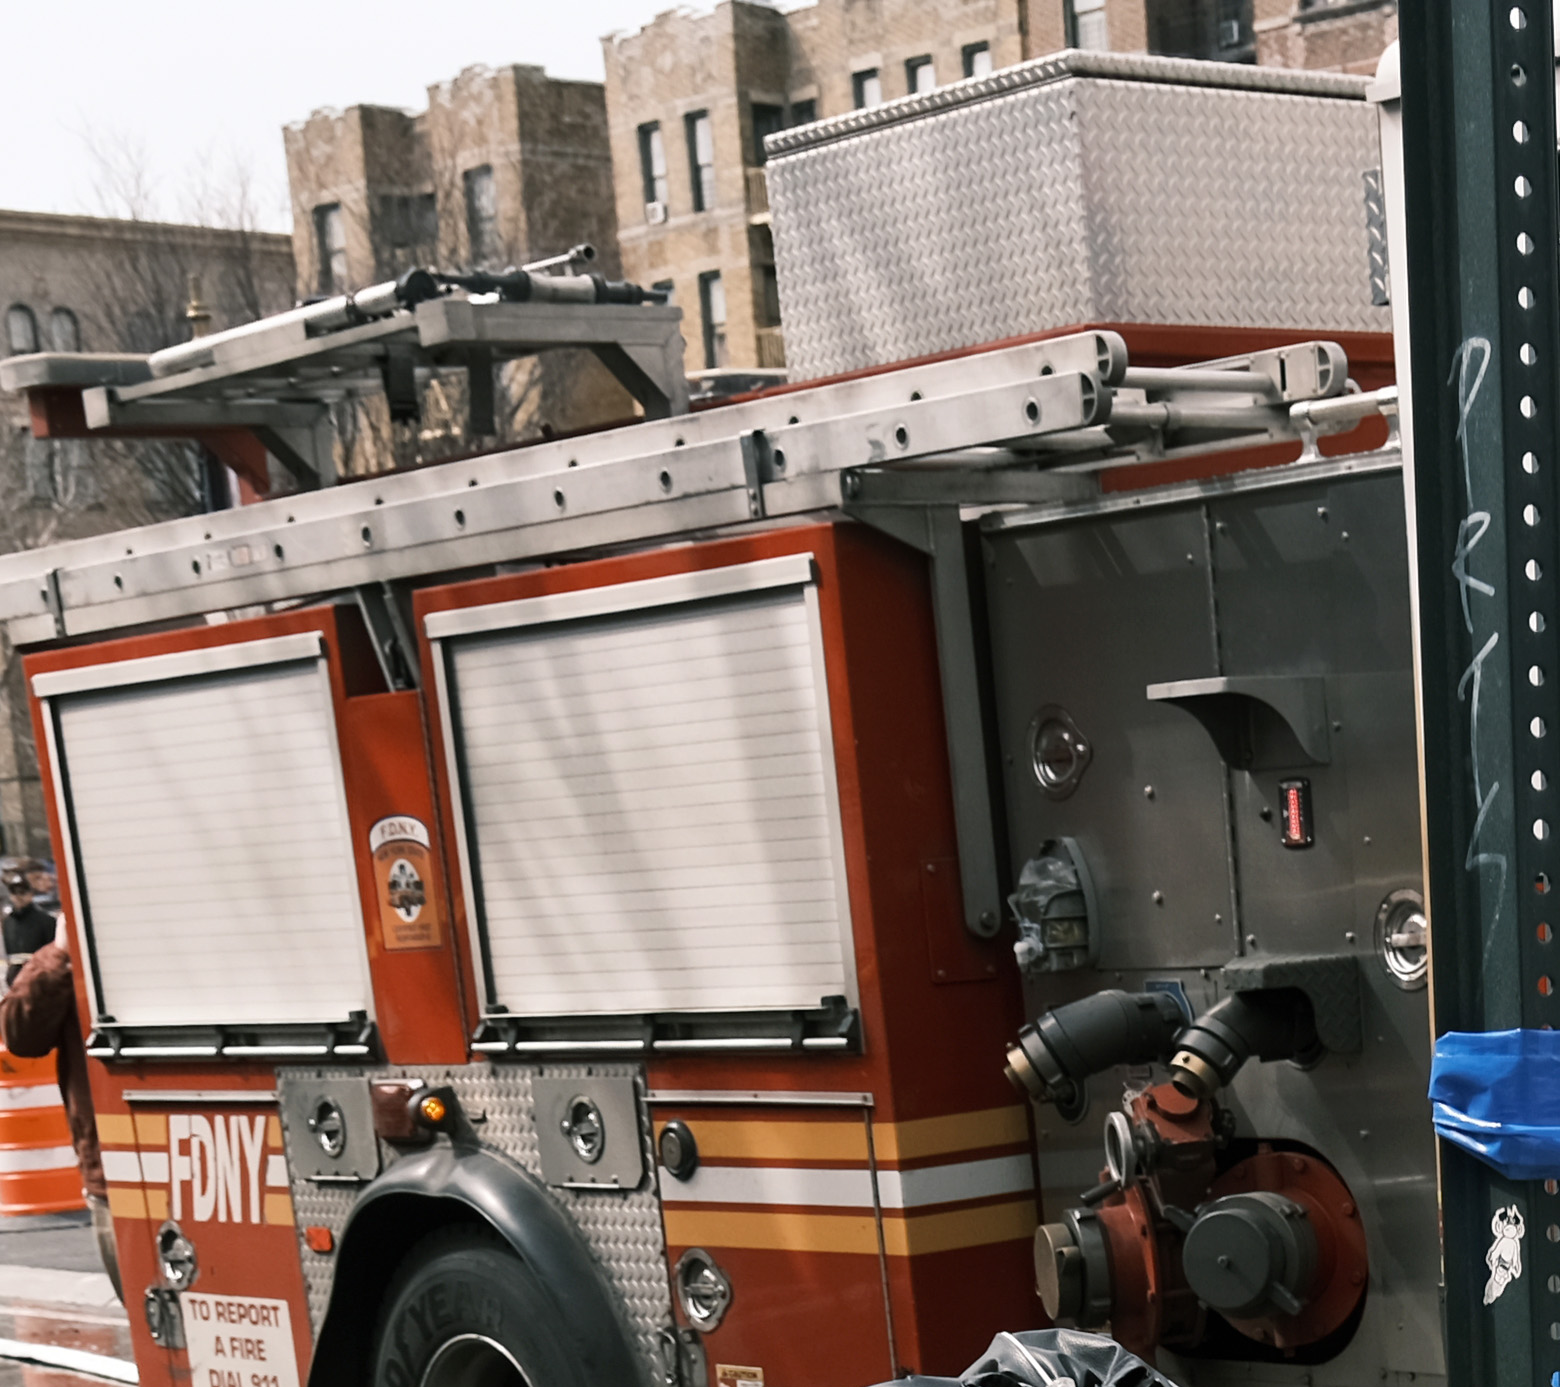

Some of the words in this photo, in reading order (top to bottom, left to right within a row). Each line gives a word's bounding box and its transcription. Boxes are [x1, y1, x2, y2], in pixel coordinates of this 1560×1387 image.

[169, 1114, 266, 1225] FDNY
[190, 1298, 210, 1322] TO
[216, 1301, 280, 1328] REPORT
[214, 1336, 226, 1359] A
[230, 1337, 267, 1362] FIRE
